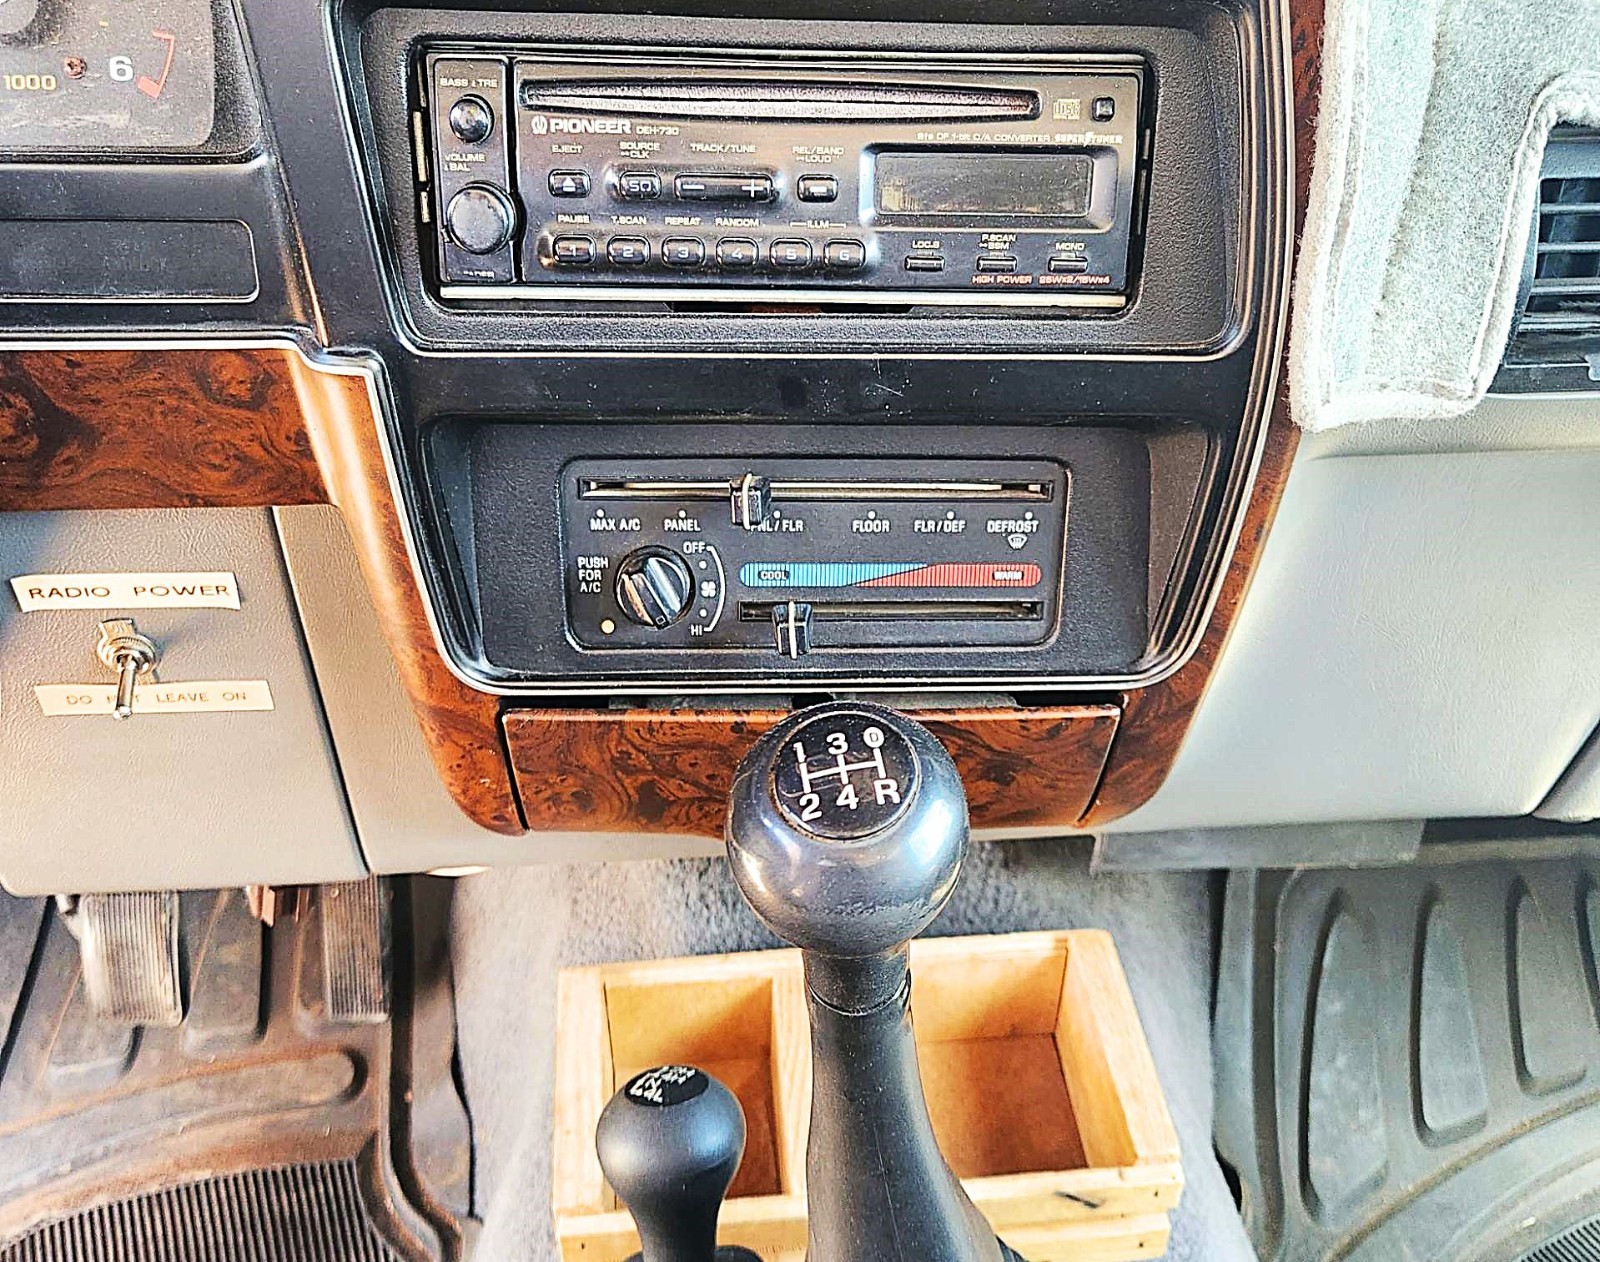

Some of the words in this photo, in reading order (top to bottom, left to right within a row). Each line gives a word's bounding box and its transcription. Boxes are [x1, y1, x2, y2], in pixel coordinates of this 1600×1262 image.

[109, 56, 134, 82] 6
[3, 74, 57, 91] 1000
[439, 78, 469, 88] BASS
[478, 79, 498, 88] TRE
[550, 119, 632, 135] PIONEER
[636, 126, 679, 136] DEH-730
[994, 134, 1049, 143] CONVERTER
[552, 145, 583, 154] EJECT
[620, 142, 660, 151] SOURCE
[690, 143, 757, 154] TRACK/TUNE
[793, 146, 844, 156] REL/BAND
[445, 154, 486, 163] VOLUME
[630, 151, 650, 159] CLK
[805, 155, 832, 163] LOUD
[450, 163, 470, 172] BAL
[558, 215, 590, 224] PAUSE
[612, 216, 647, 225] T.SCAN
[665, 217, 699, 226] REPEAT
[715, 218, 760, 228] RANDOM
[981, 234, 1016, 243] P.SCAN
[569, 244, 580, 257] 1
[623, 246, 634, 258] 2
[1055, 242, 1084, 251] MONO
[678, 247, 689, 258] 3
[731, 249, 743, 260] 4
[786, 250, 796, 260] 5
[972, 275, 994, 284] HIGH
[997, 275, 1032, 284] POWER
[590, 518, 616, 531] MAX
[619, 518, 641, 531] A/C
[664, 519, 701, 532] PANEL
[852, 519, 890, 533] FLOOR
[913, 519, 966, 533] FLR/DEF
[986, 519, 1039, 534] DEFROST
[683, 541, 705, 554] OFF
[577, 557, 609, 569] PUSH
[579, 569, 602, 581] FOR
[760, 571, 788, 581] COOL
[994, 571, 1023, 581] WARM
[28, 586, 111, 599] RADIO
[133, 585, 231, 597] POWER
[580, 581, 602, 593] A/C
[691, 625, 703, 637] HI
[66, 694, 92, 705] DO
[106, 693, 140, 705] NT
[156, 692, 209, 704] LEAVE
[222, 691, 247, 702] ON
[826, 732, 848, 755] 3
[793, 741, 806, 763] 1
[836, 784, 859, 810] 4
[874, 778, 900, 806] R
[800, 793, 823, 822] 2
